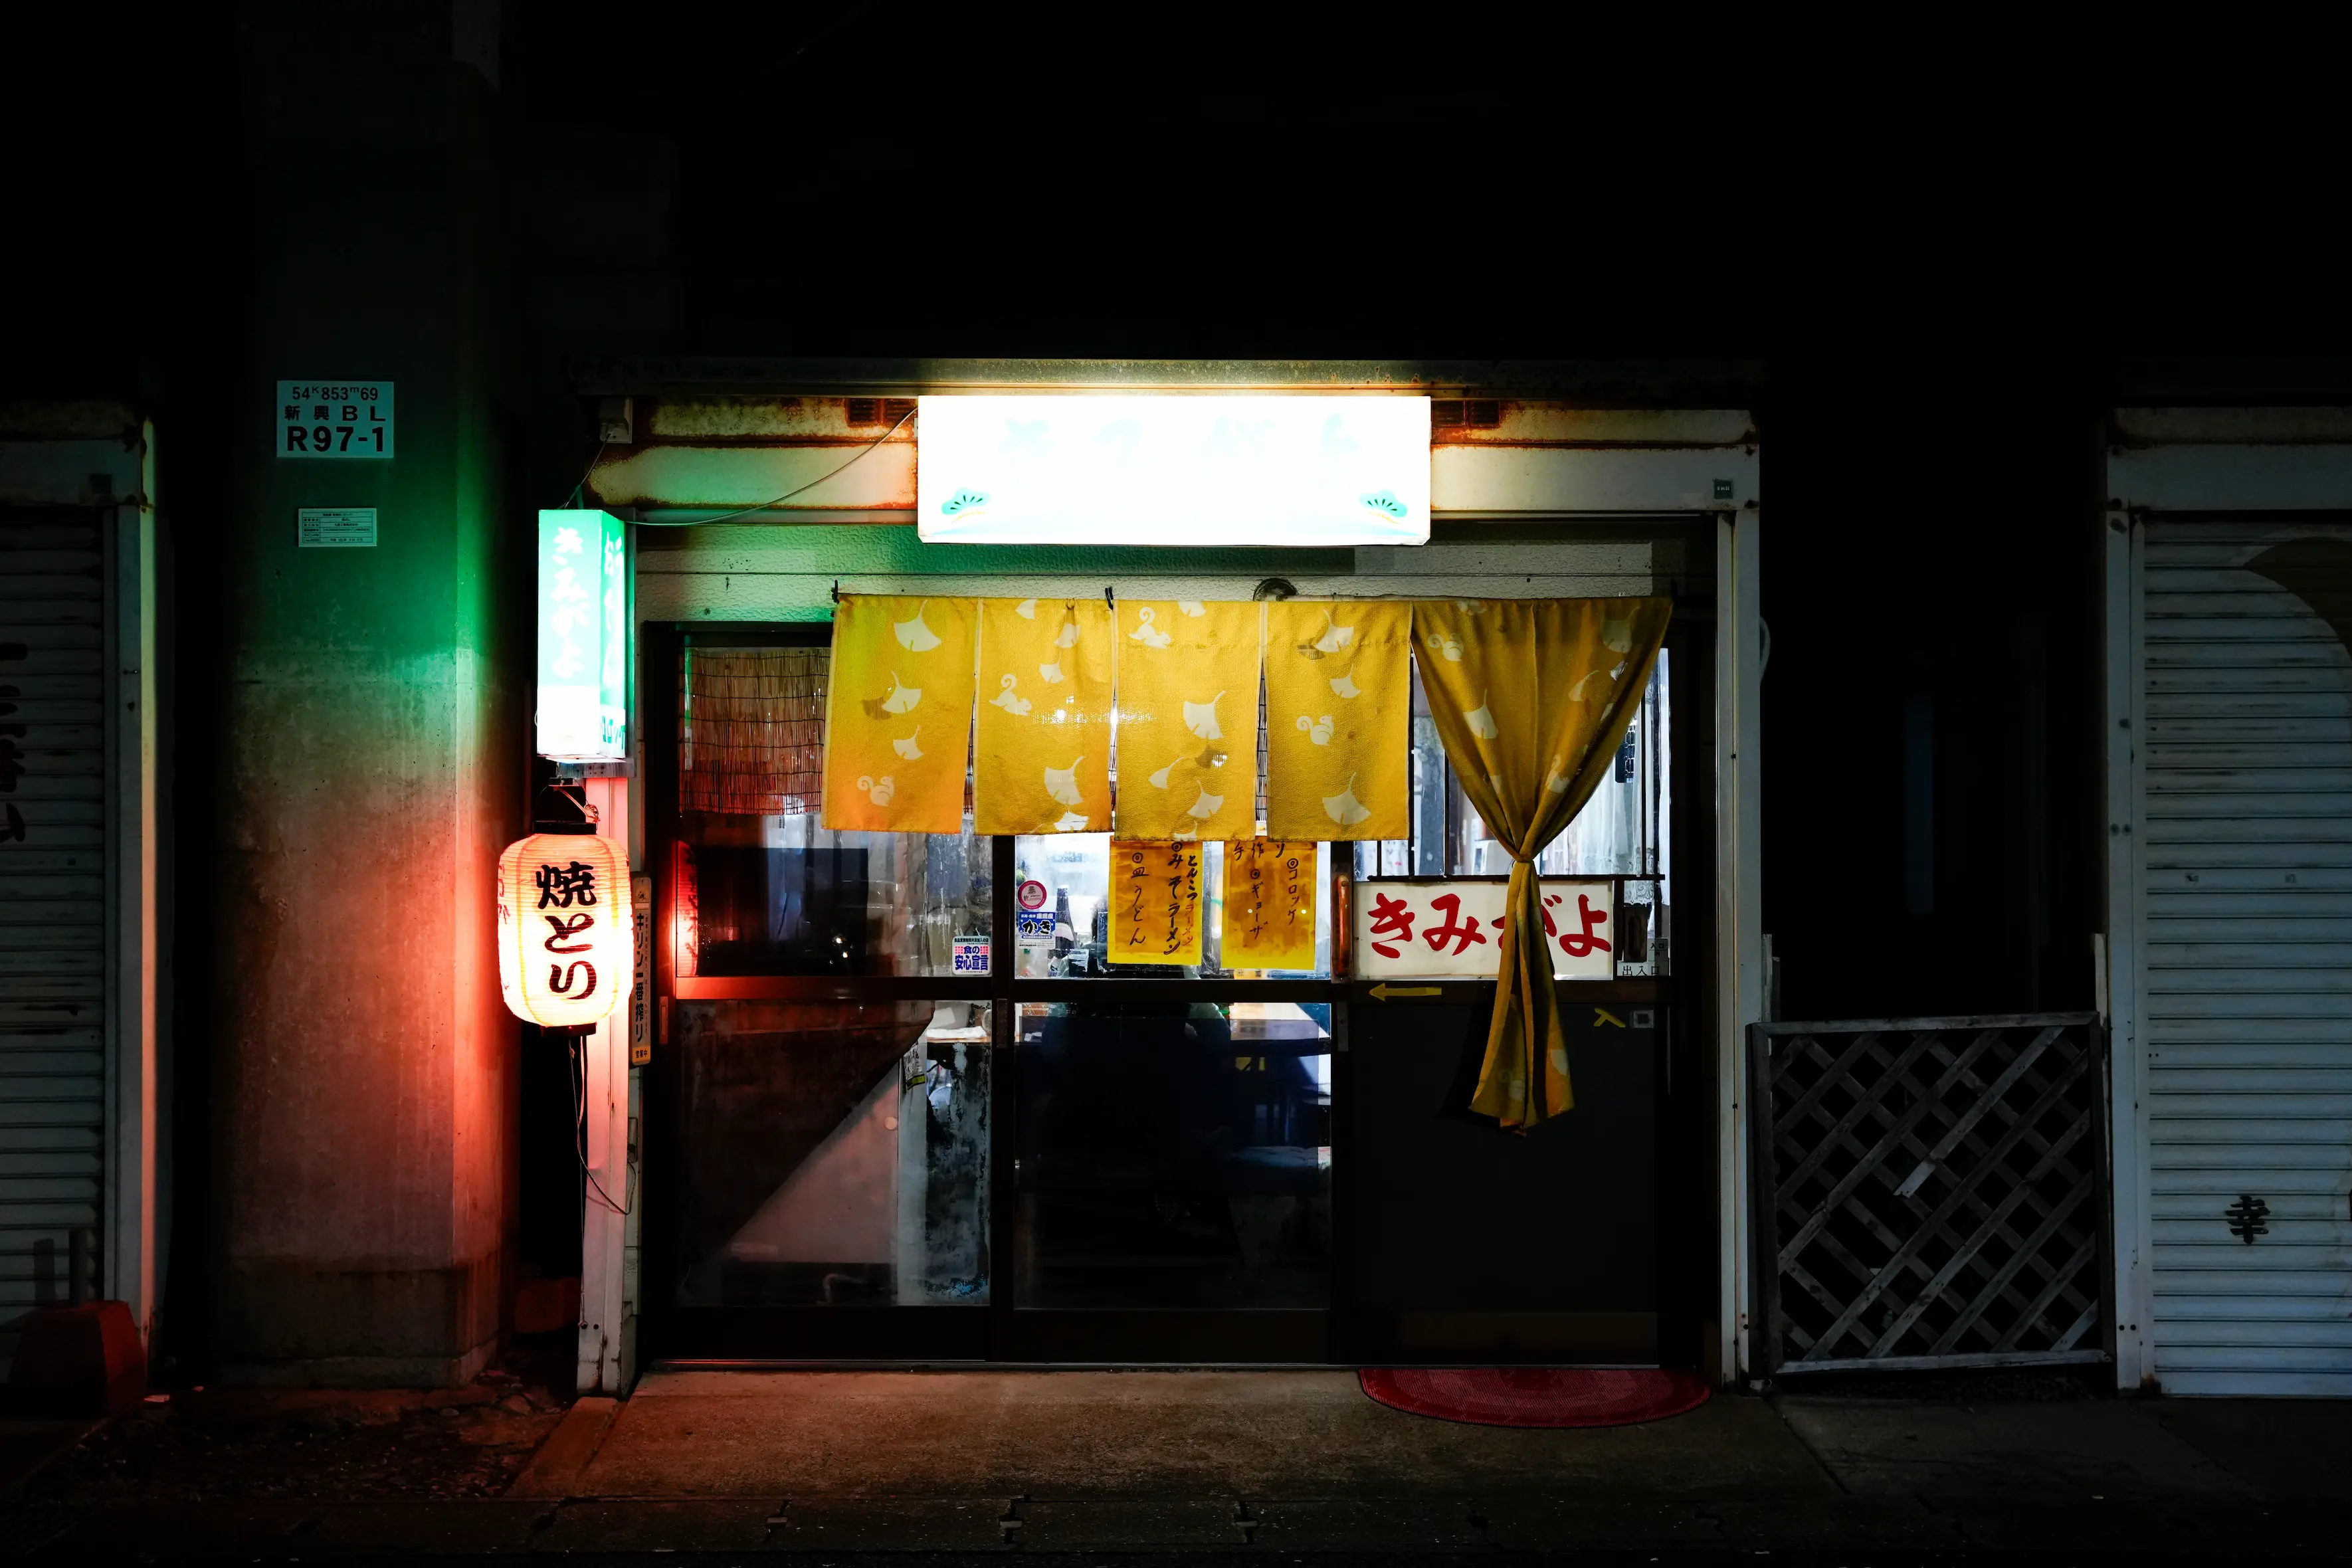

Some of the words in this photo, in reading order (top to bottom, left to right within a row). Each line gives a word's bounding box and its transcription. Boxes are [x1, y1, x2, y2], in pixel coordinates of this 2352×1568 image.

[287, 425, 383, 452] R97-1
[536, 861, 597, 999] 焼とり
[1023, 920, 1050, 935] かき
[963, 945, 980, 954] 食の
[955, 954, 989, 970] 安心宣言
[635, 912, 644, 1042] キリン一番搾り
[1622, 965, 1660, 976] 出入口
[635, 1048, 648, 1059] 営業中
[2225, 1195, 2270, 1244] 幸
